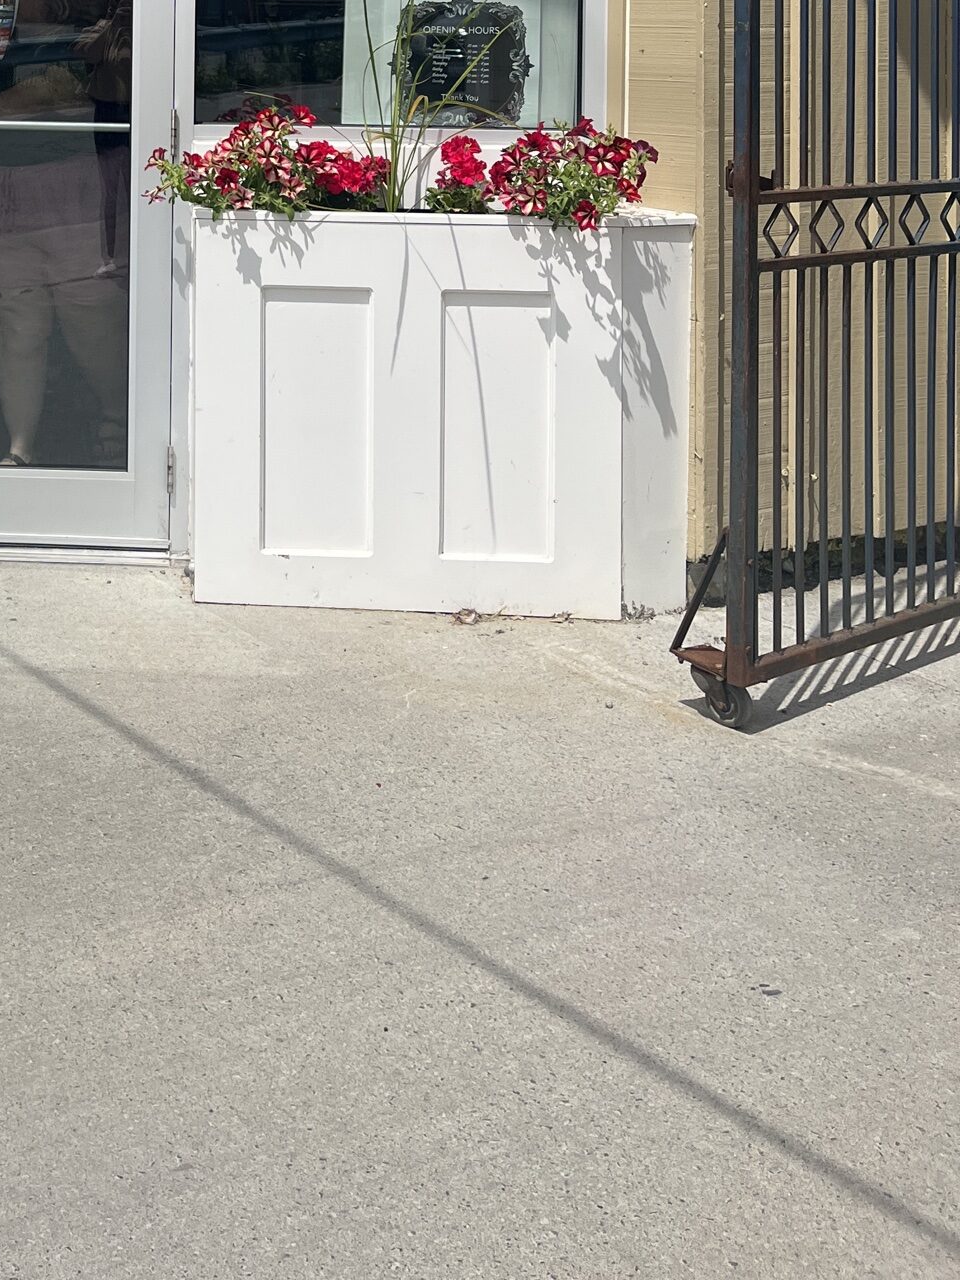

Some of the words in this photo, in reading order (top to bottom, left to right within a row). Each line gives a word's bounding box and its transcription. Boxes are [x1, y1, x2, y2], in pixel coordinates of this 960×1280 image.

[423, 25, 465, 35] OPENIN
[468, 26, 500, 35] HOURS
[465, 94, 479, 102] You
